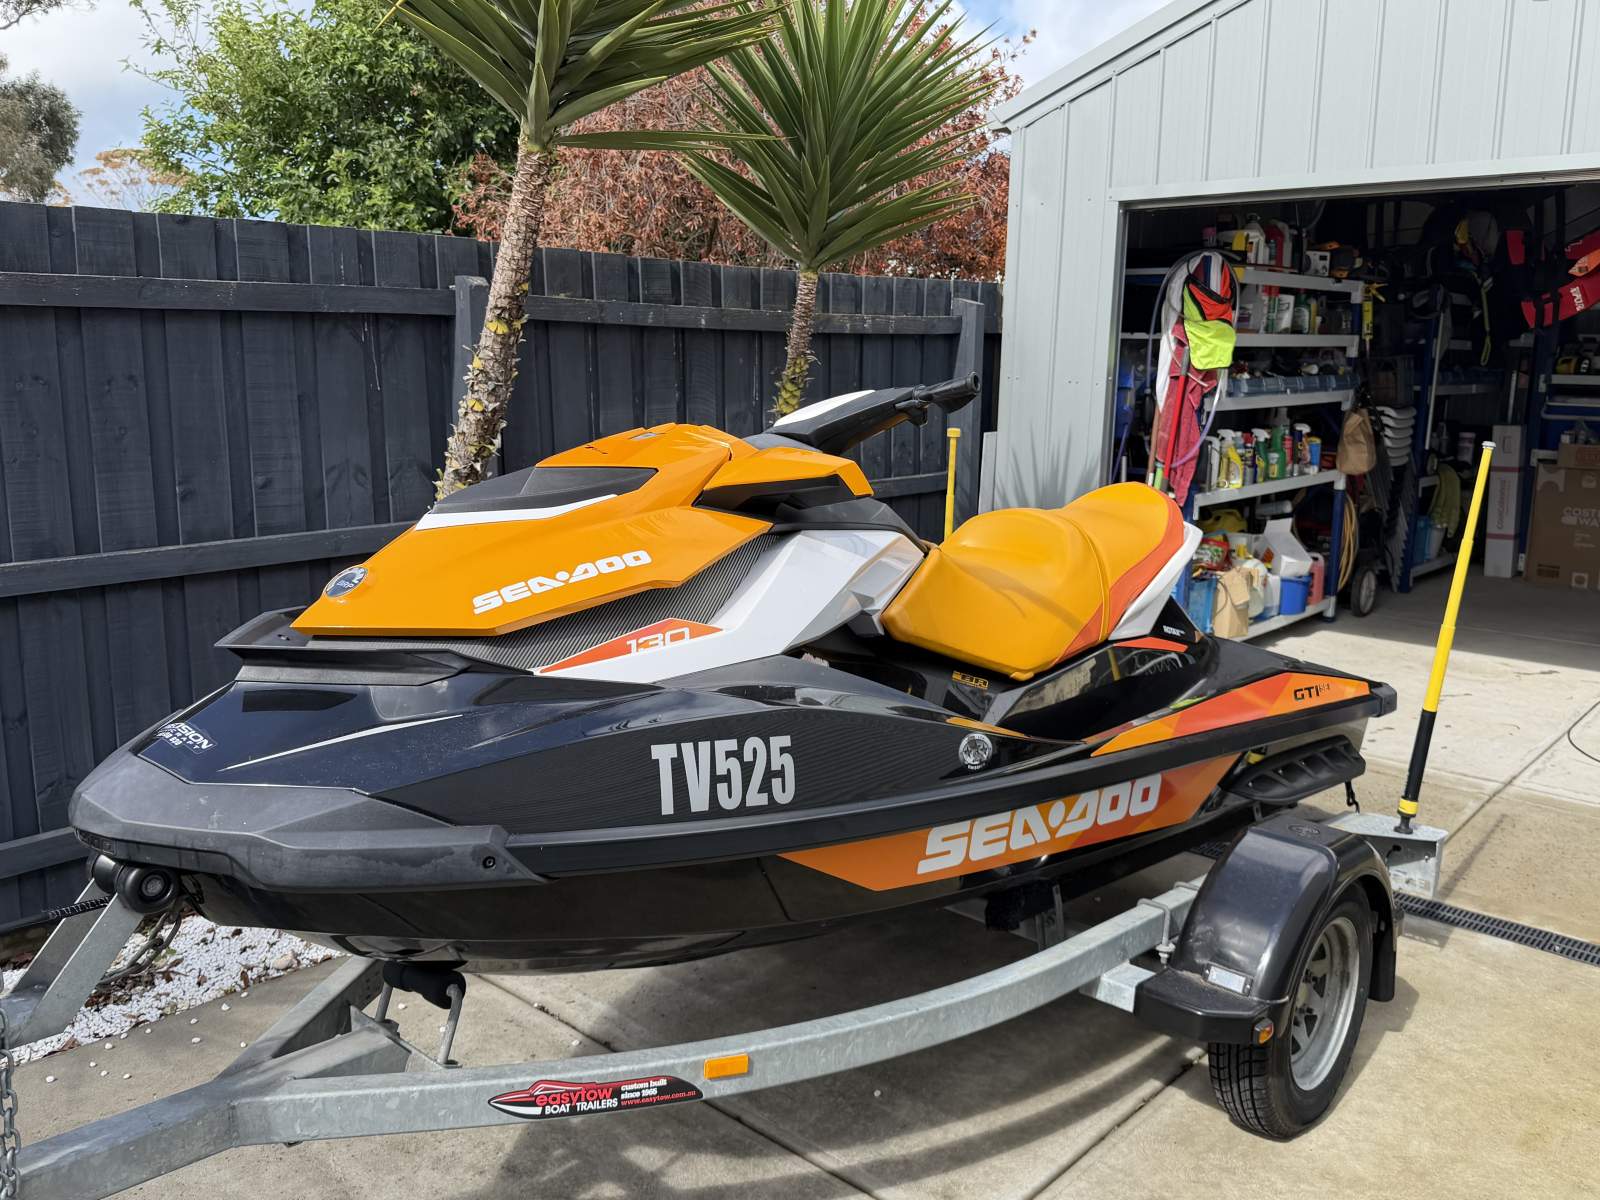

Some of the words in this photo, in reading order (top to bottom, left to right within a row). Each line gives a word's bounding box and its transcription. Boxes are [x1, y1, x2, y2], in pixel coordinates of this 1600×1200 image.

[627, 627, 690, 655] 130
[651, 735, 796, 816] TV525
[650, 1079, 668, 1088] built
[536, 1088, 612, 1106] easytow
[620, 1090, 641, 1099] since
[544, 1103, 571, 1115] BOAT
[576, 1097, 619, 1113] TRAILERS
